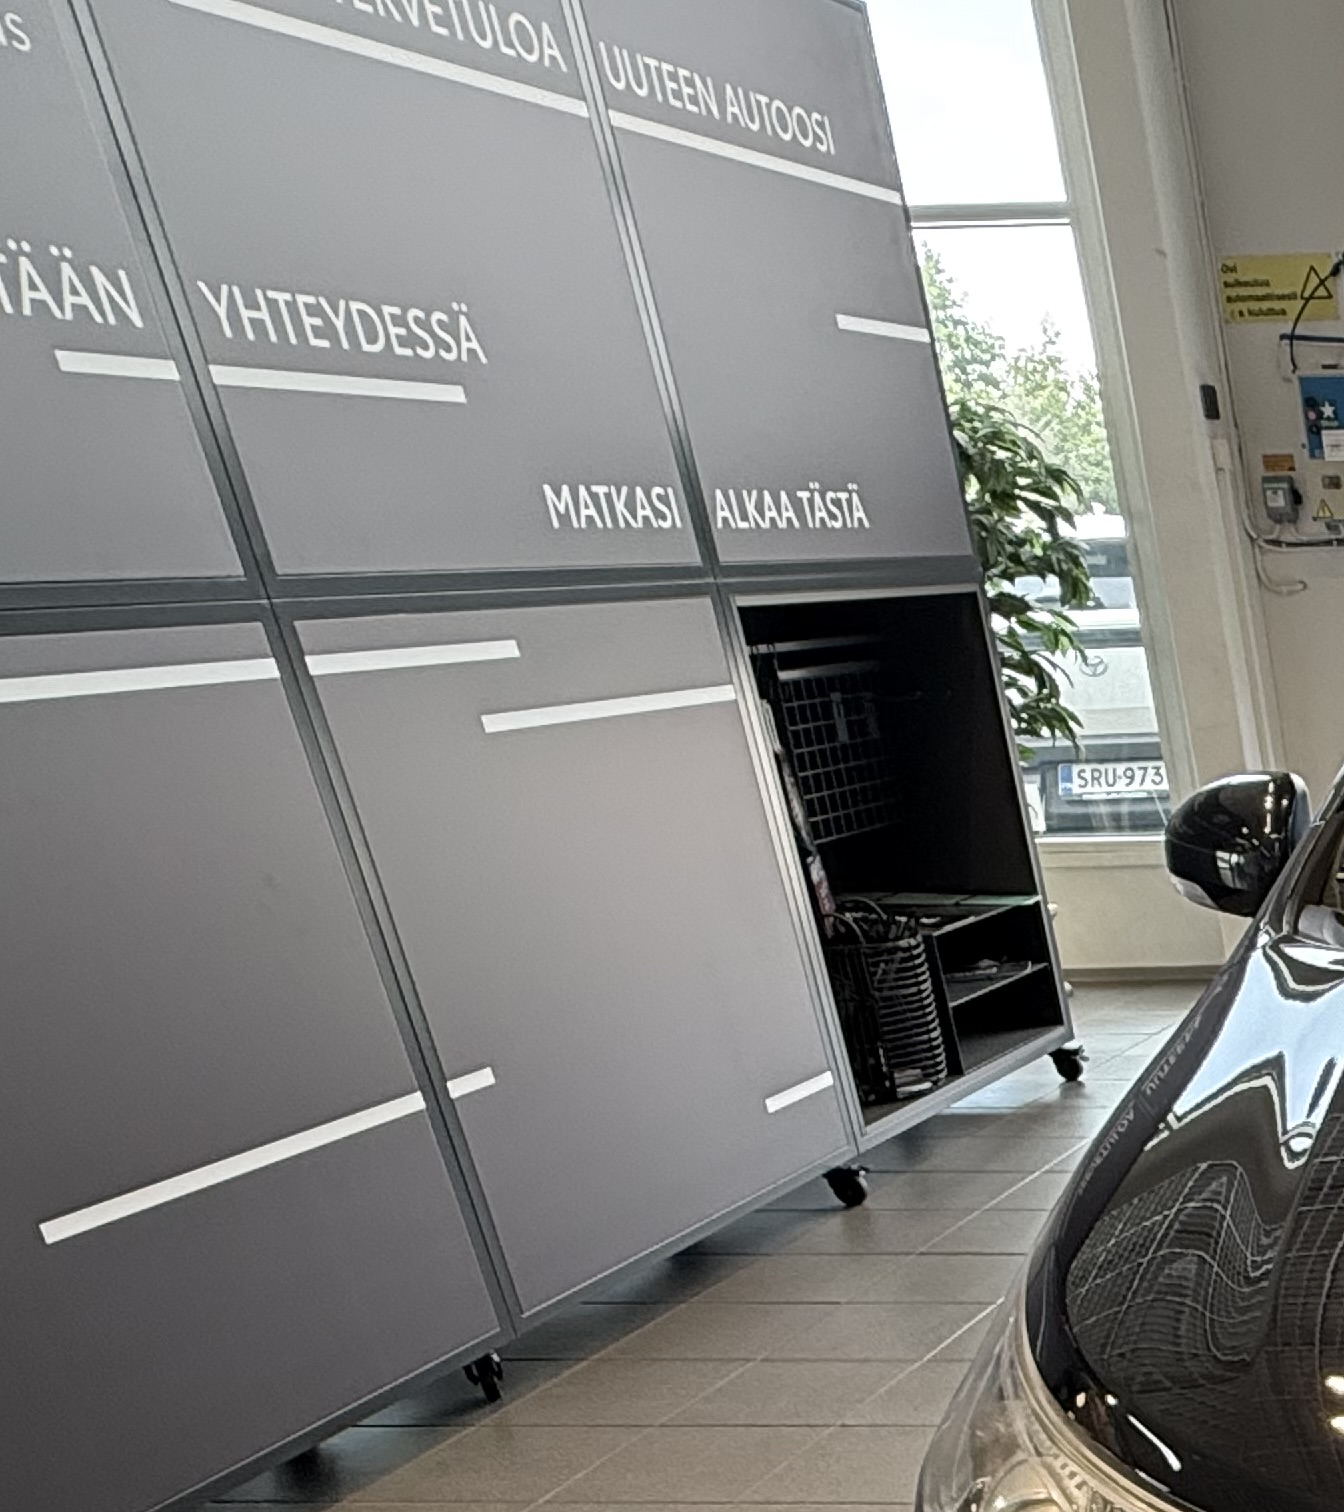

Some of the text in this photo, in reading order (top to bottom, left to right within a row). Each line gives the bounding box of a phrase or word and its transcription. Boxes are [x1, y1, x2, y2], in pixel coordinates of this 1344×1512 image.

[336, 0, 836, 156] VETULOA UUTEEN AUTOOSI
[196, 280, 488, 364] YHTEYDESSÄ
[542, 481, 870, 529] MATKASI ALKAA TÄSTÄ
[1077, 766, 1164, 788] SRU-973
